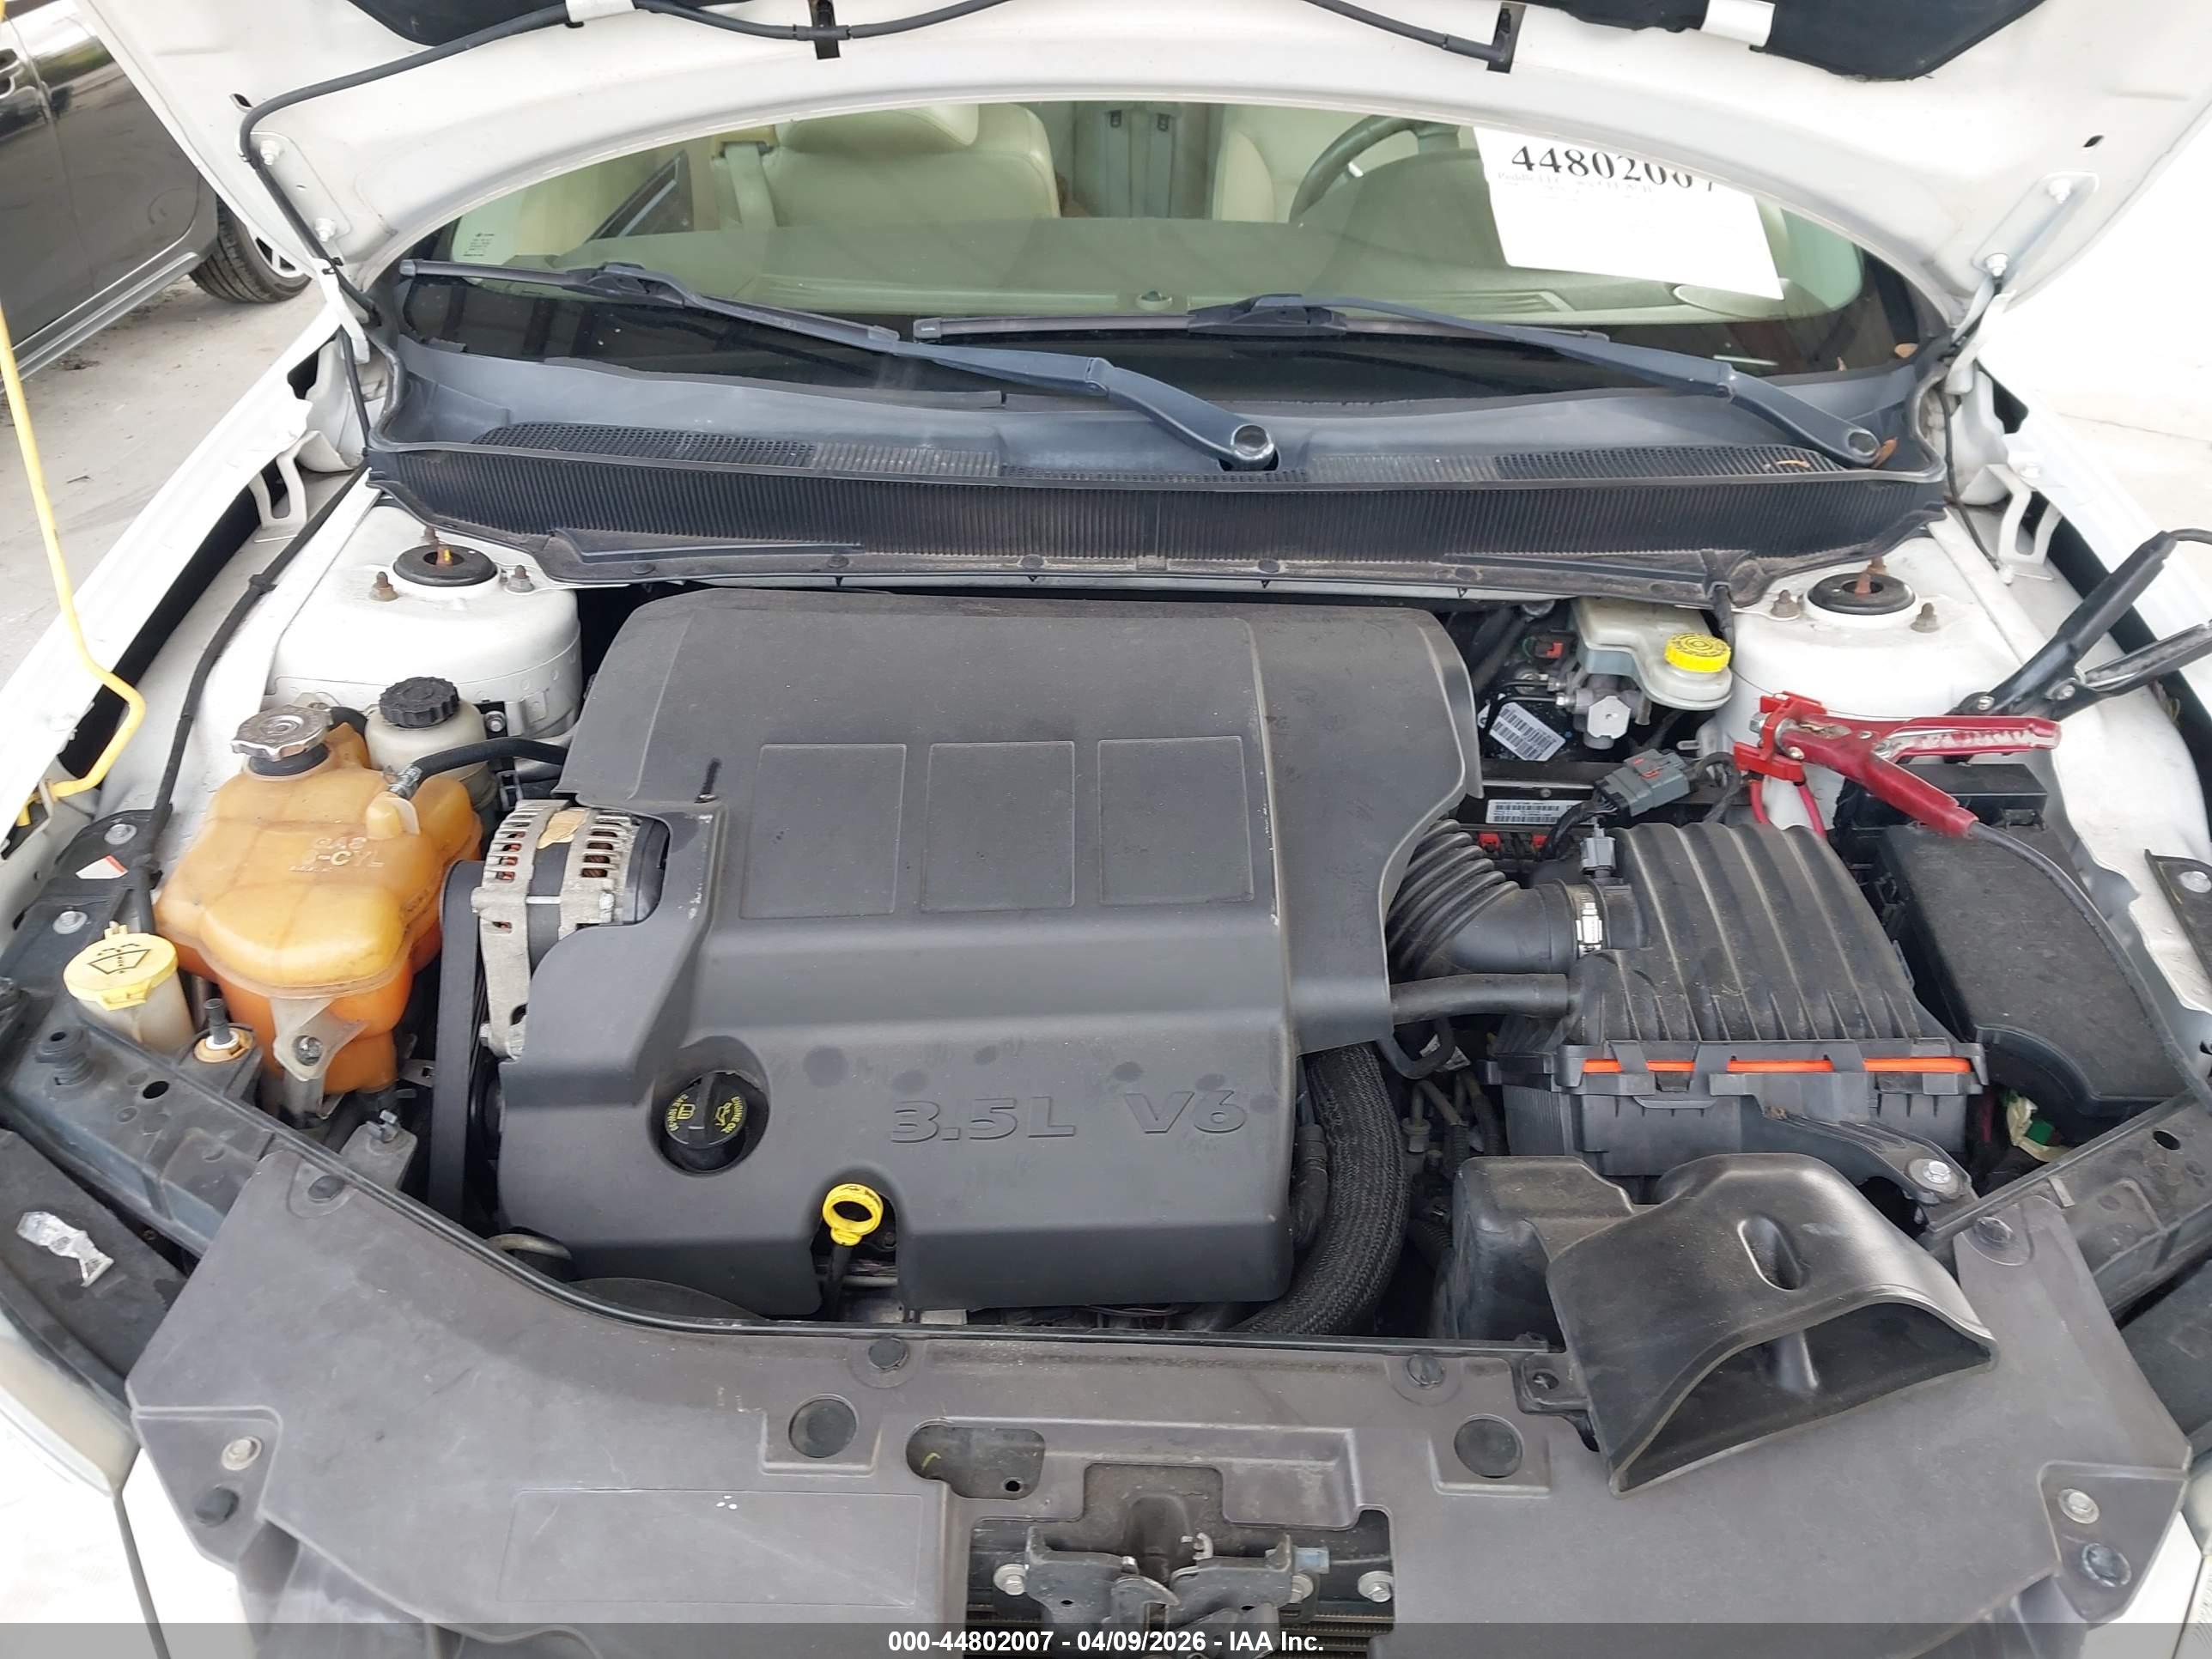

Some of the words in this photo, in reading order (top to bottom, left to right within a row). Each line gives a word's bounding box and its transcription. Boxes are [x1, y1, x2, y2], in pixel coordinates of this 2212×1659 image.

[731, 1096, 743, 1122] ENGINE
[890, 1096, 1077, 1144] 3.5L
[1124, 1090, 1248, 1134] V6
